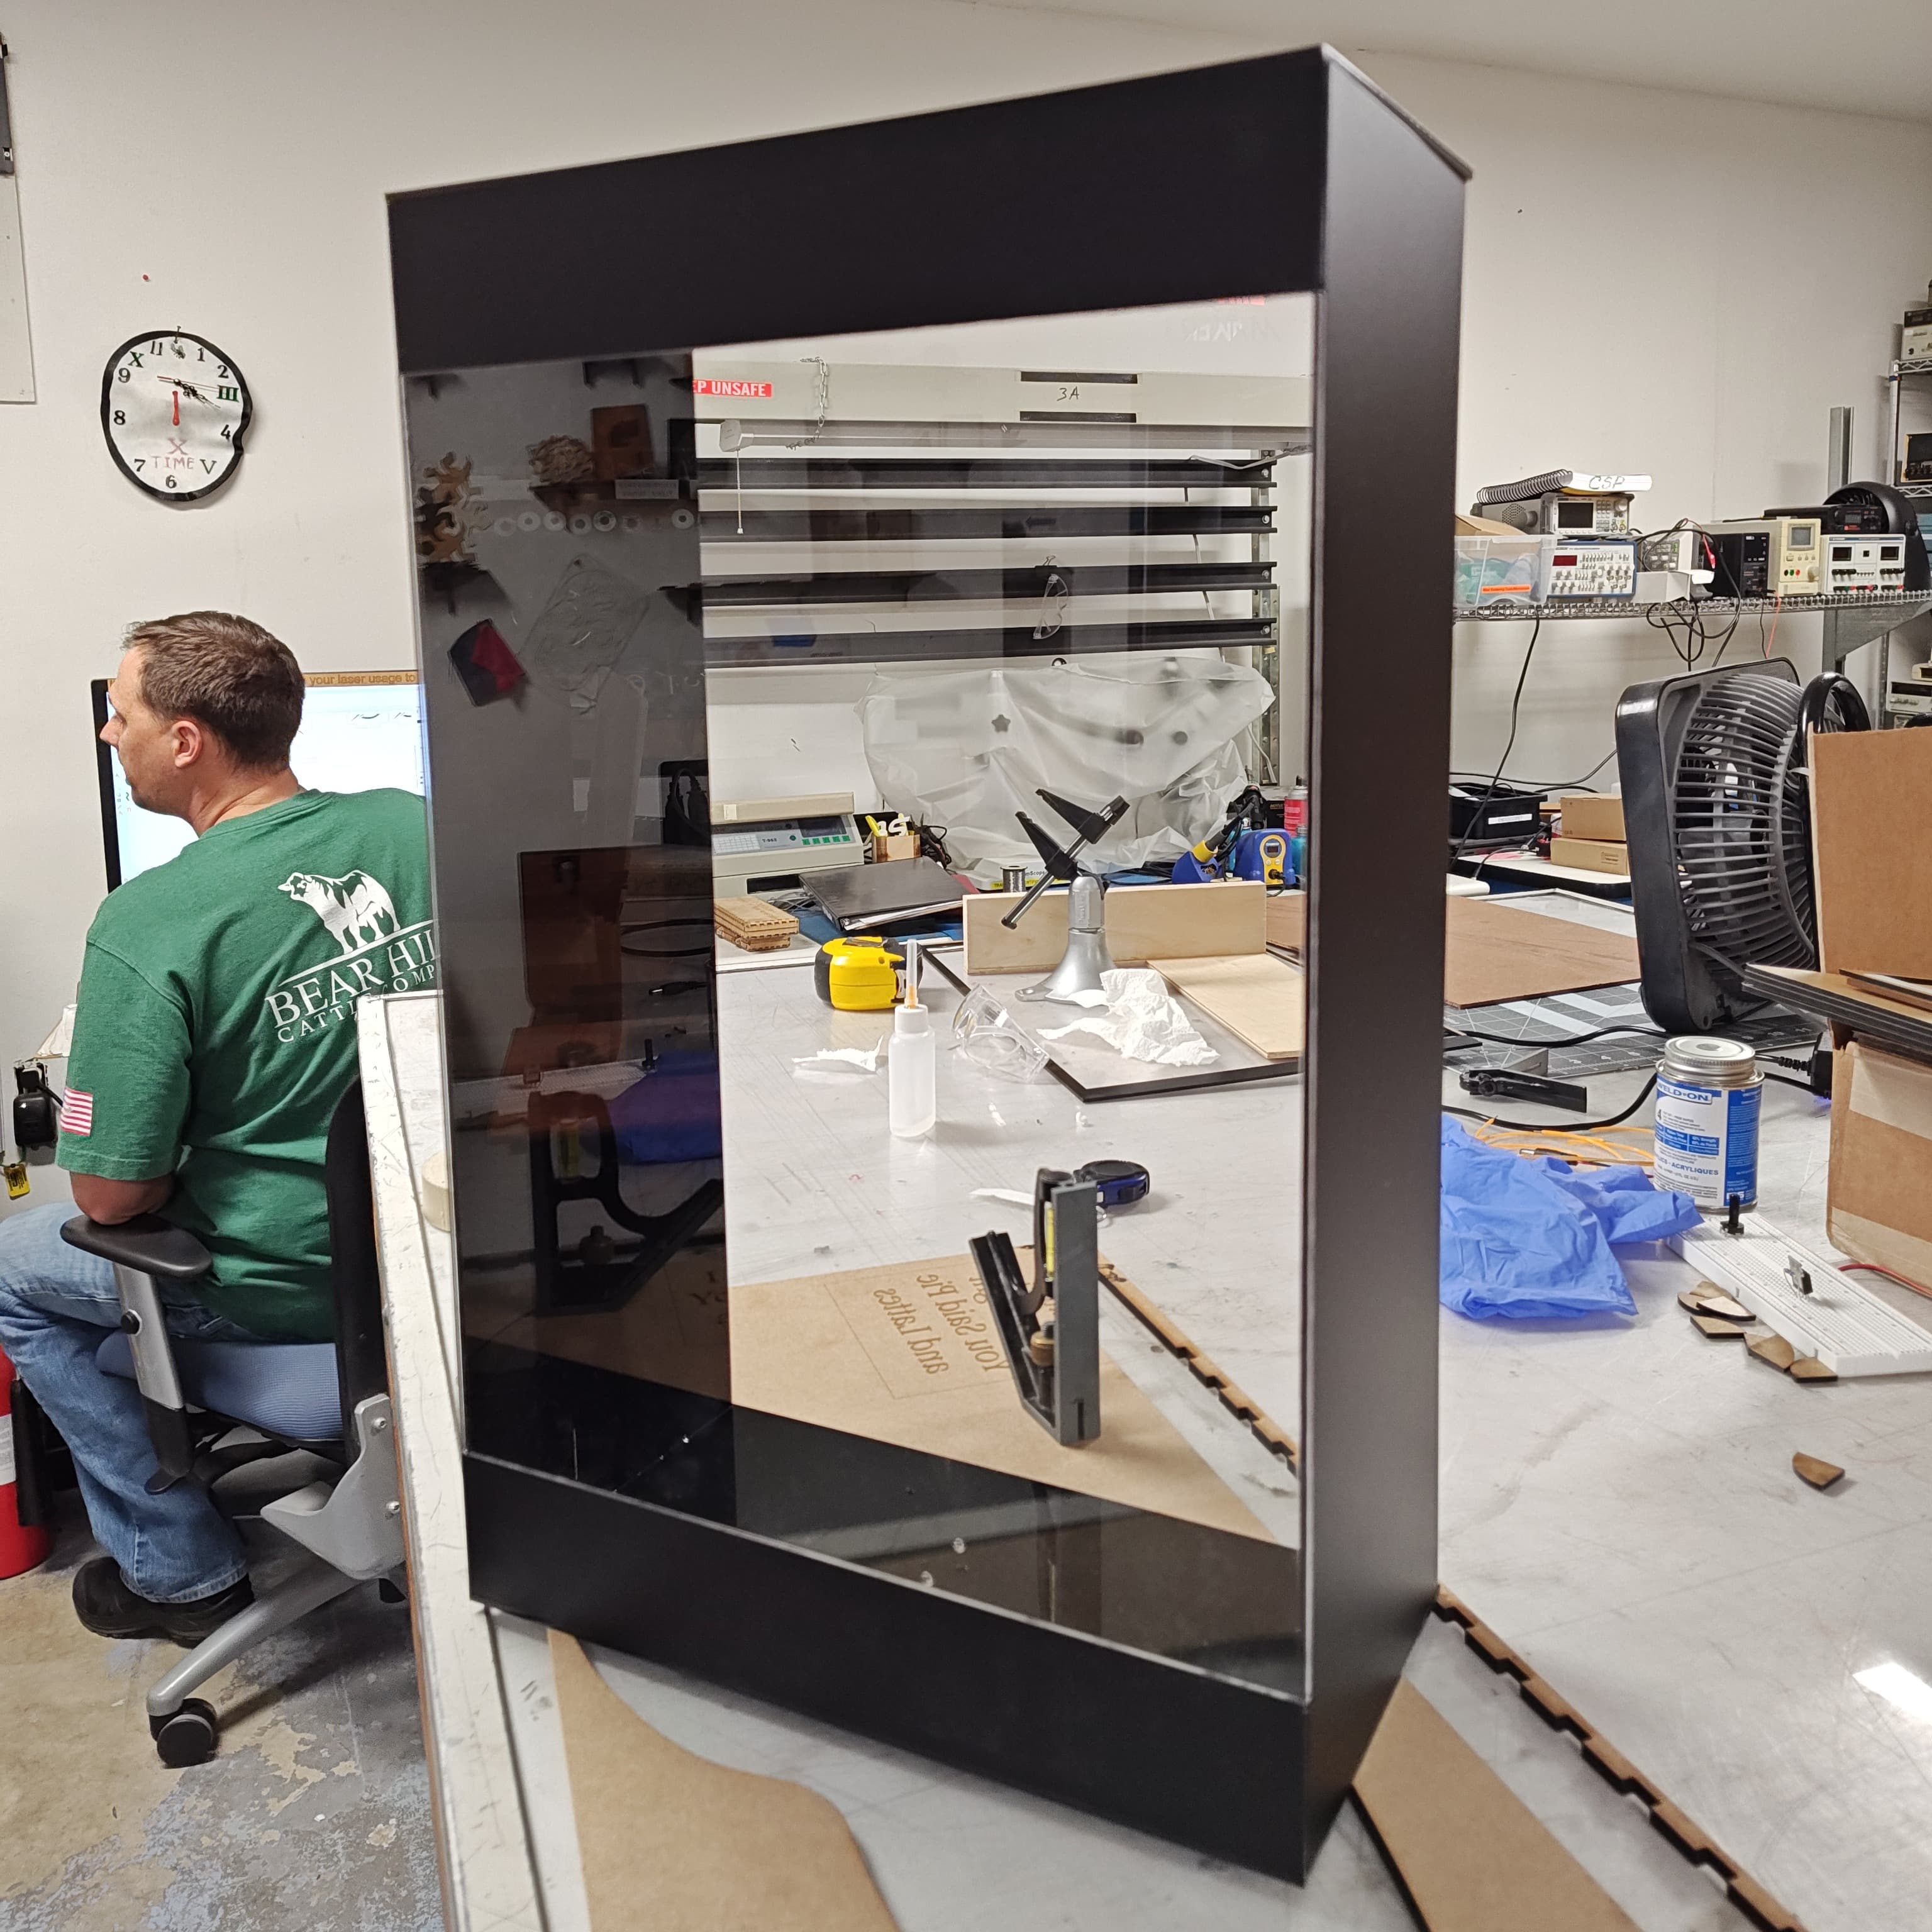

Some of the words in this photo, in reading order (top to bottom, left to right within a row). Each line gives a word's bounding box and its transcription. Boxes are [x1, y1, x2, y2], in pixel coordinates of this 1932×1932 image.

[150, 341, 163, 356] 11
[197, 347, 206, 362] 1
[128, 351, 145, 368] X
[118, 368, 131, 384] 9
[217, 365, 229, 379] 2
[217, 385, 239, 402] III
[711, 380, 767, 396] UNSAFE
[113, 410, 126, 425] 8
[220, 425, 231, 440] 4
[167, 438, 189, 455] X
[133, 458, 146, 472] 7
[151, 456, 195, 470] TIME
[199, 458, 217, 474] V
[165, 475, 177, 489] 6
[309, 675, 335, 686] your
[338, 674, 365, 684] laser
[369, 674, 402, 684] usage
[406, 673, 416, 682] to
[265, 958, 385, 1028] BEAR
[386, 929, 440, 978] HIL
[277, 999, 358, 1043] CATTL
[1671, 1162, 1719, 1175] ACRYLIQUES
